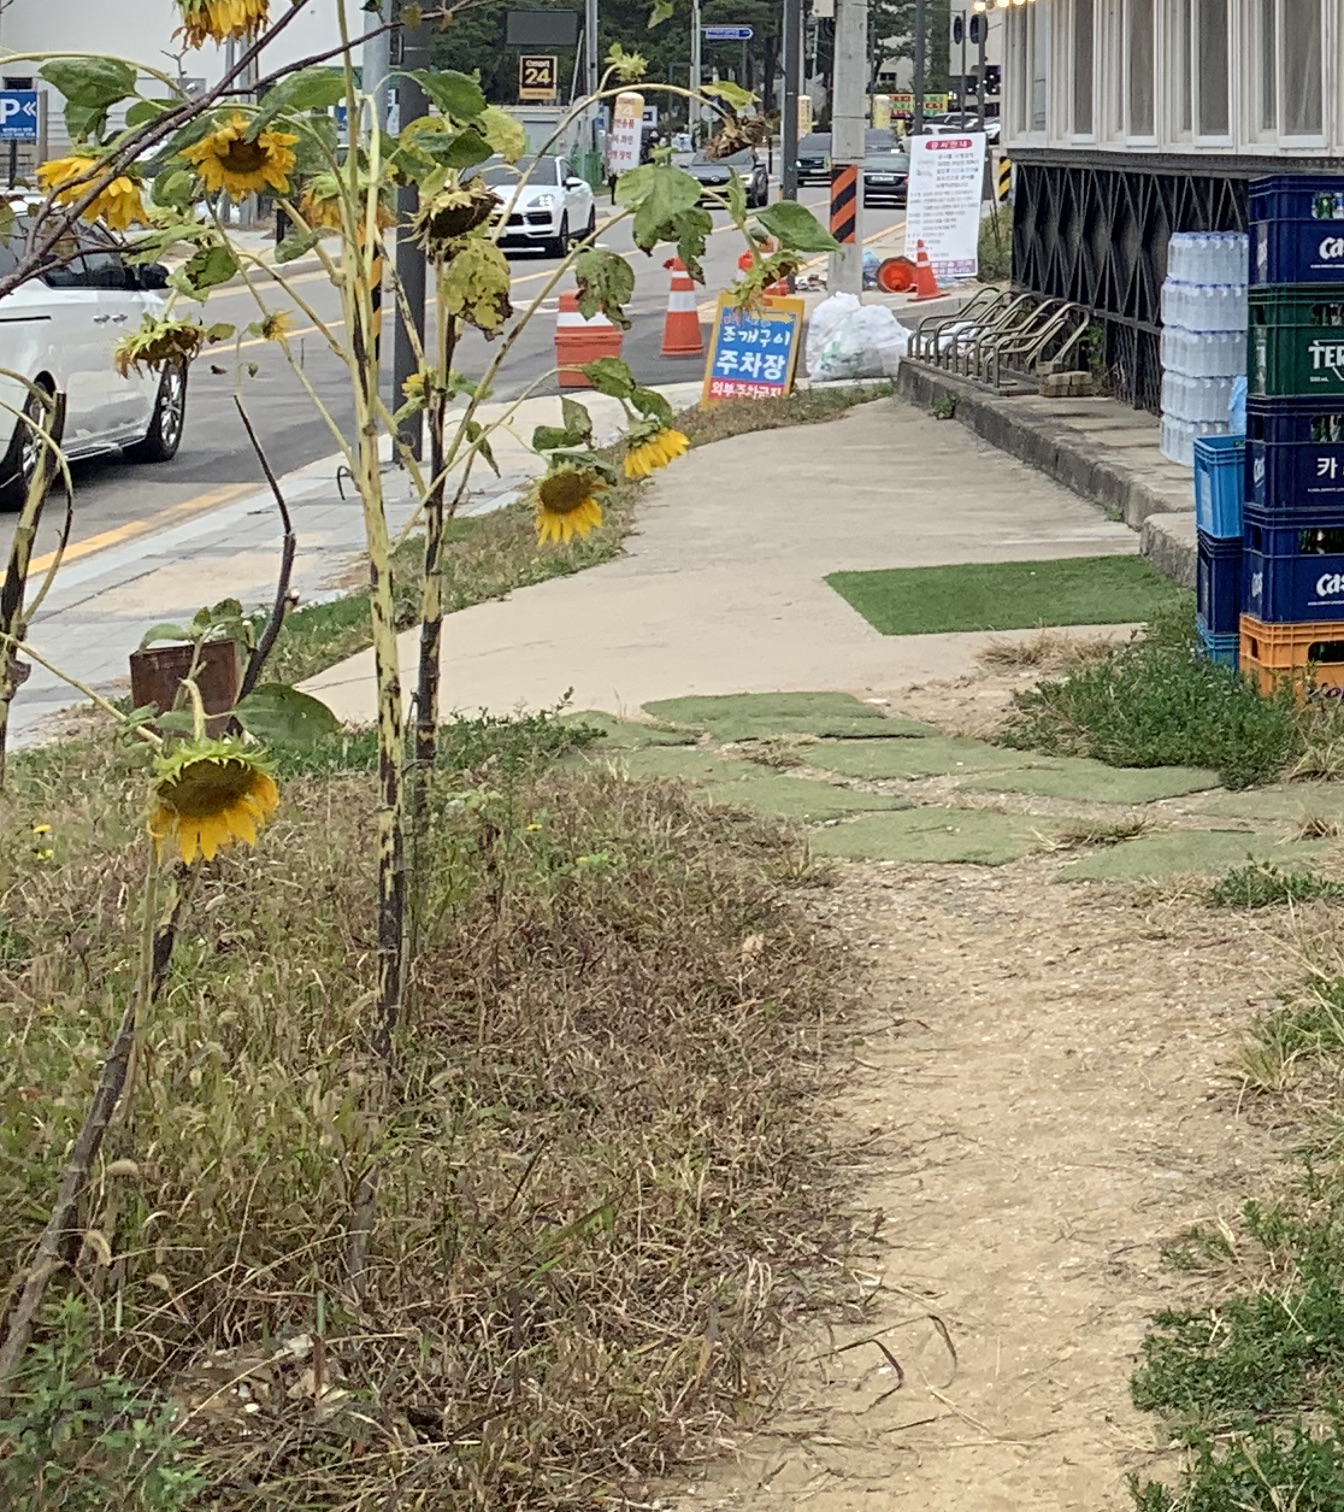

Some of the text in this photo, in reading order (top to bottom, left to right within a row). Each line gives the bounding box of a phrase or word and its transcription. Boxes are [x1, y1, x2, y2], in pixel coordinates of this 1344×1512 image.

[525, 68, 551, 85] 24
[0, 98, 21, 125] P
[722, 325, 791, 348] 조개구이
[716, 349, 786, 380] 주차장
